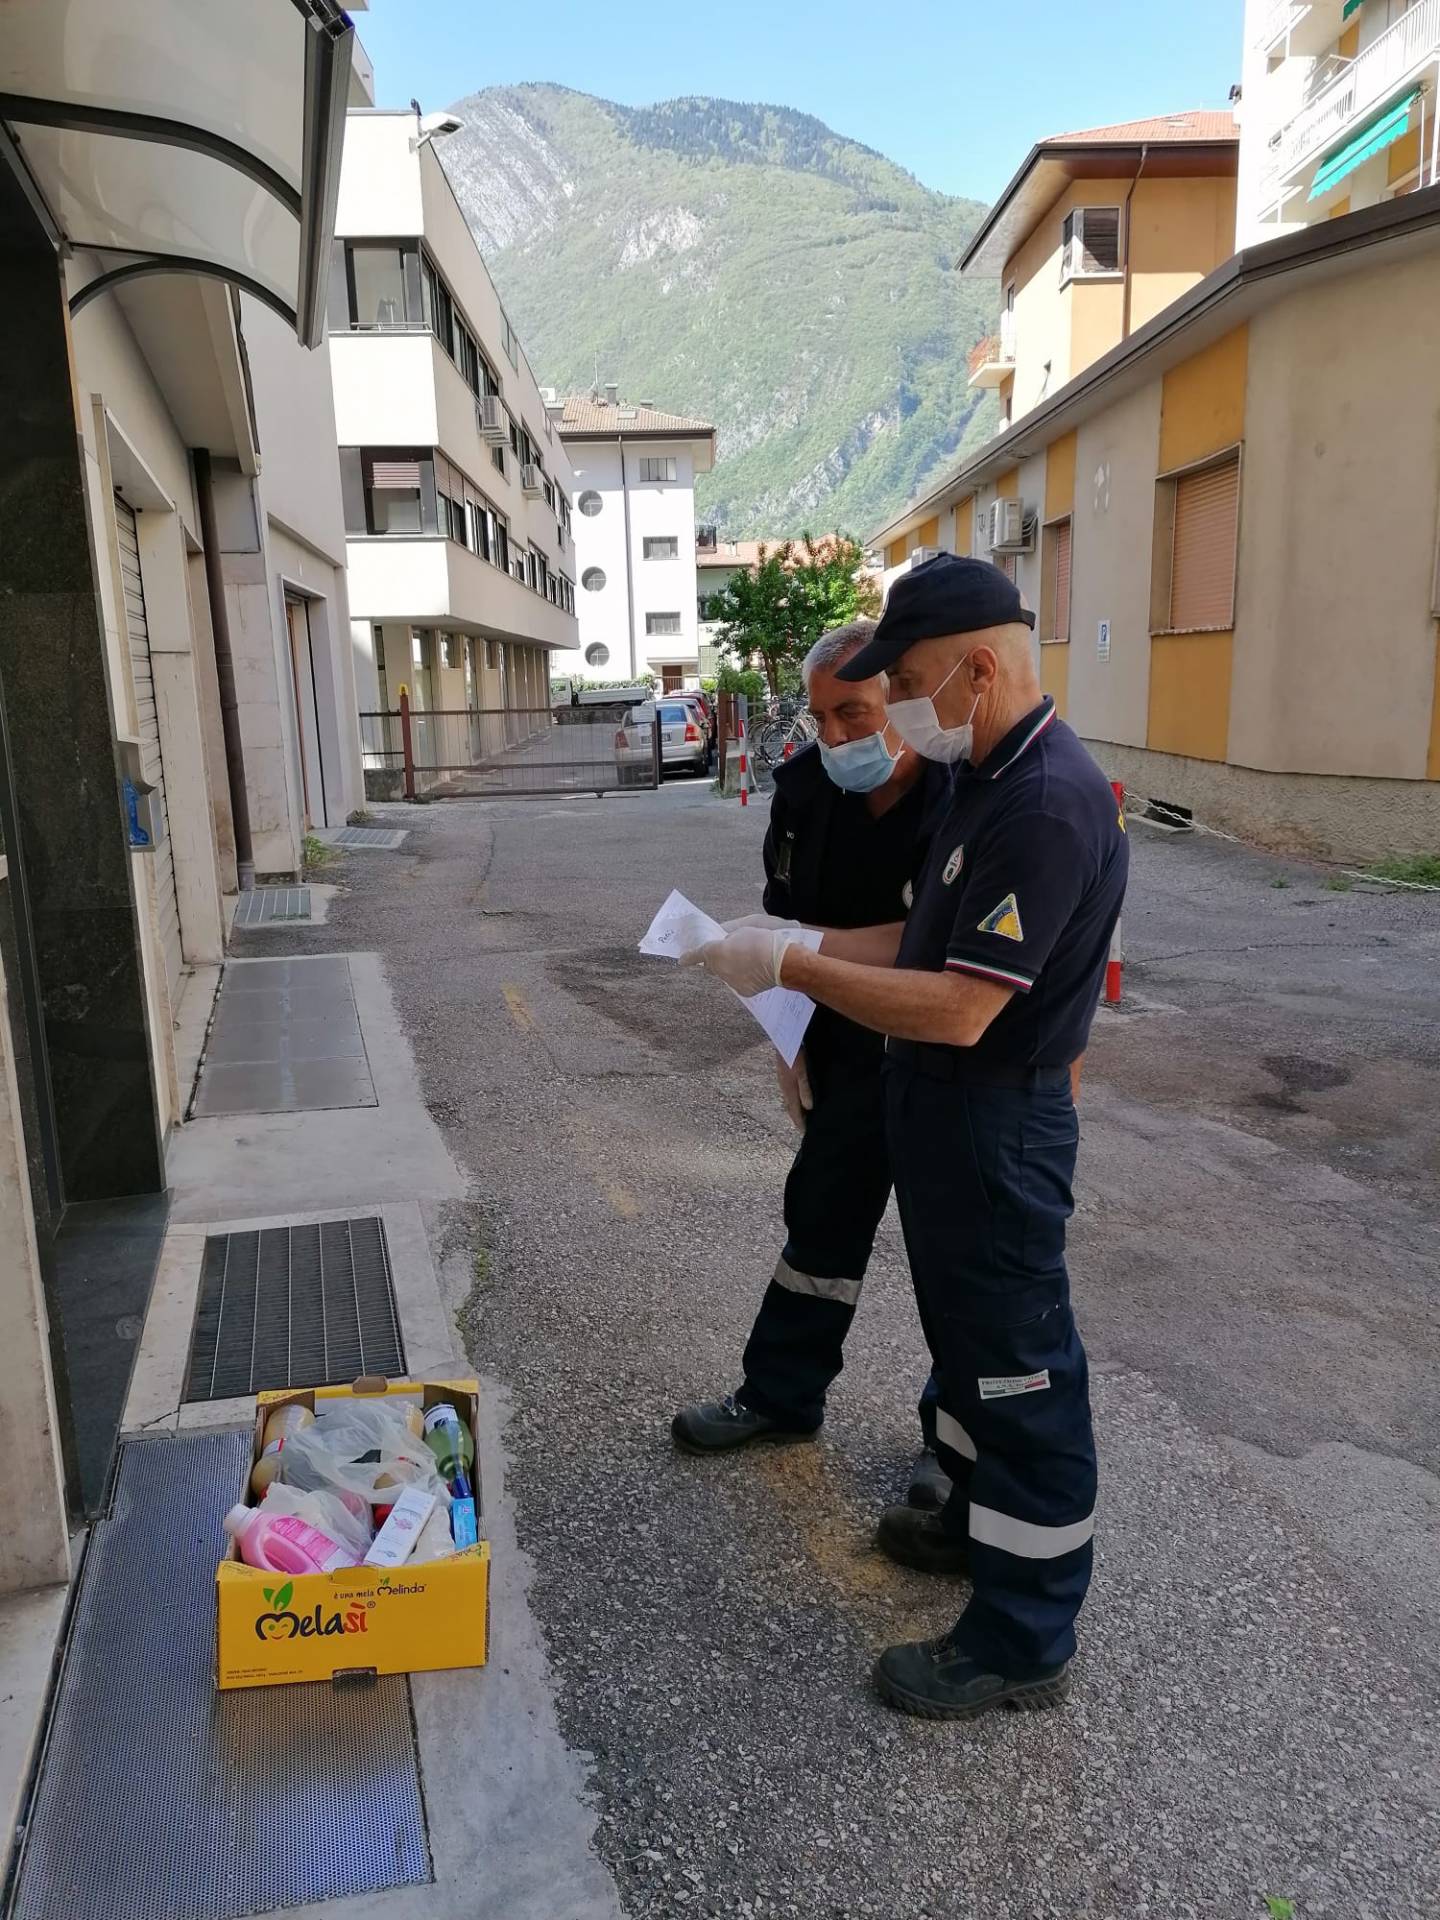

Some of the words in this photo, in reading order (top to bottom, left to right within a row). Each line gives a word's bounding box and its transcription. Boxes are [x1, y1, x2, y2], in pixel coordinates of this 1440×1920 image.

[356, 1589, 375, 1599] mela
[376, 1582, 426, 1597] Melinda
[254, 1601, 369, 1641] Melasì
